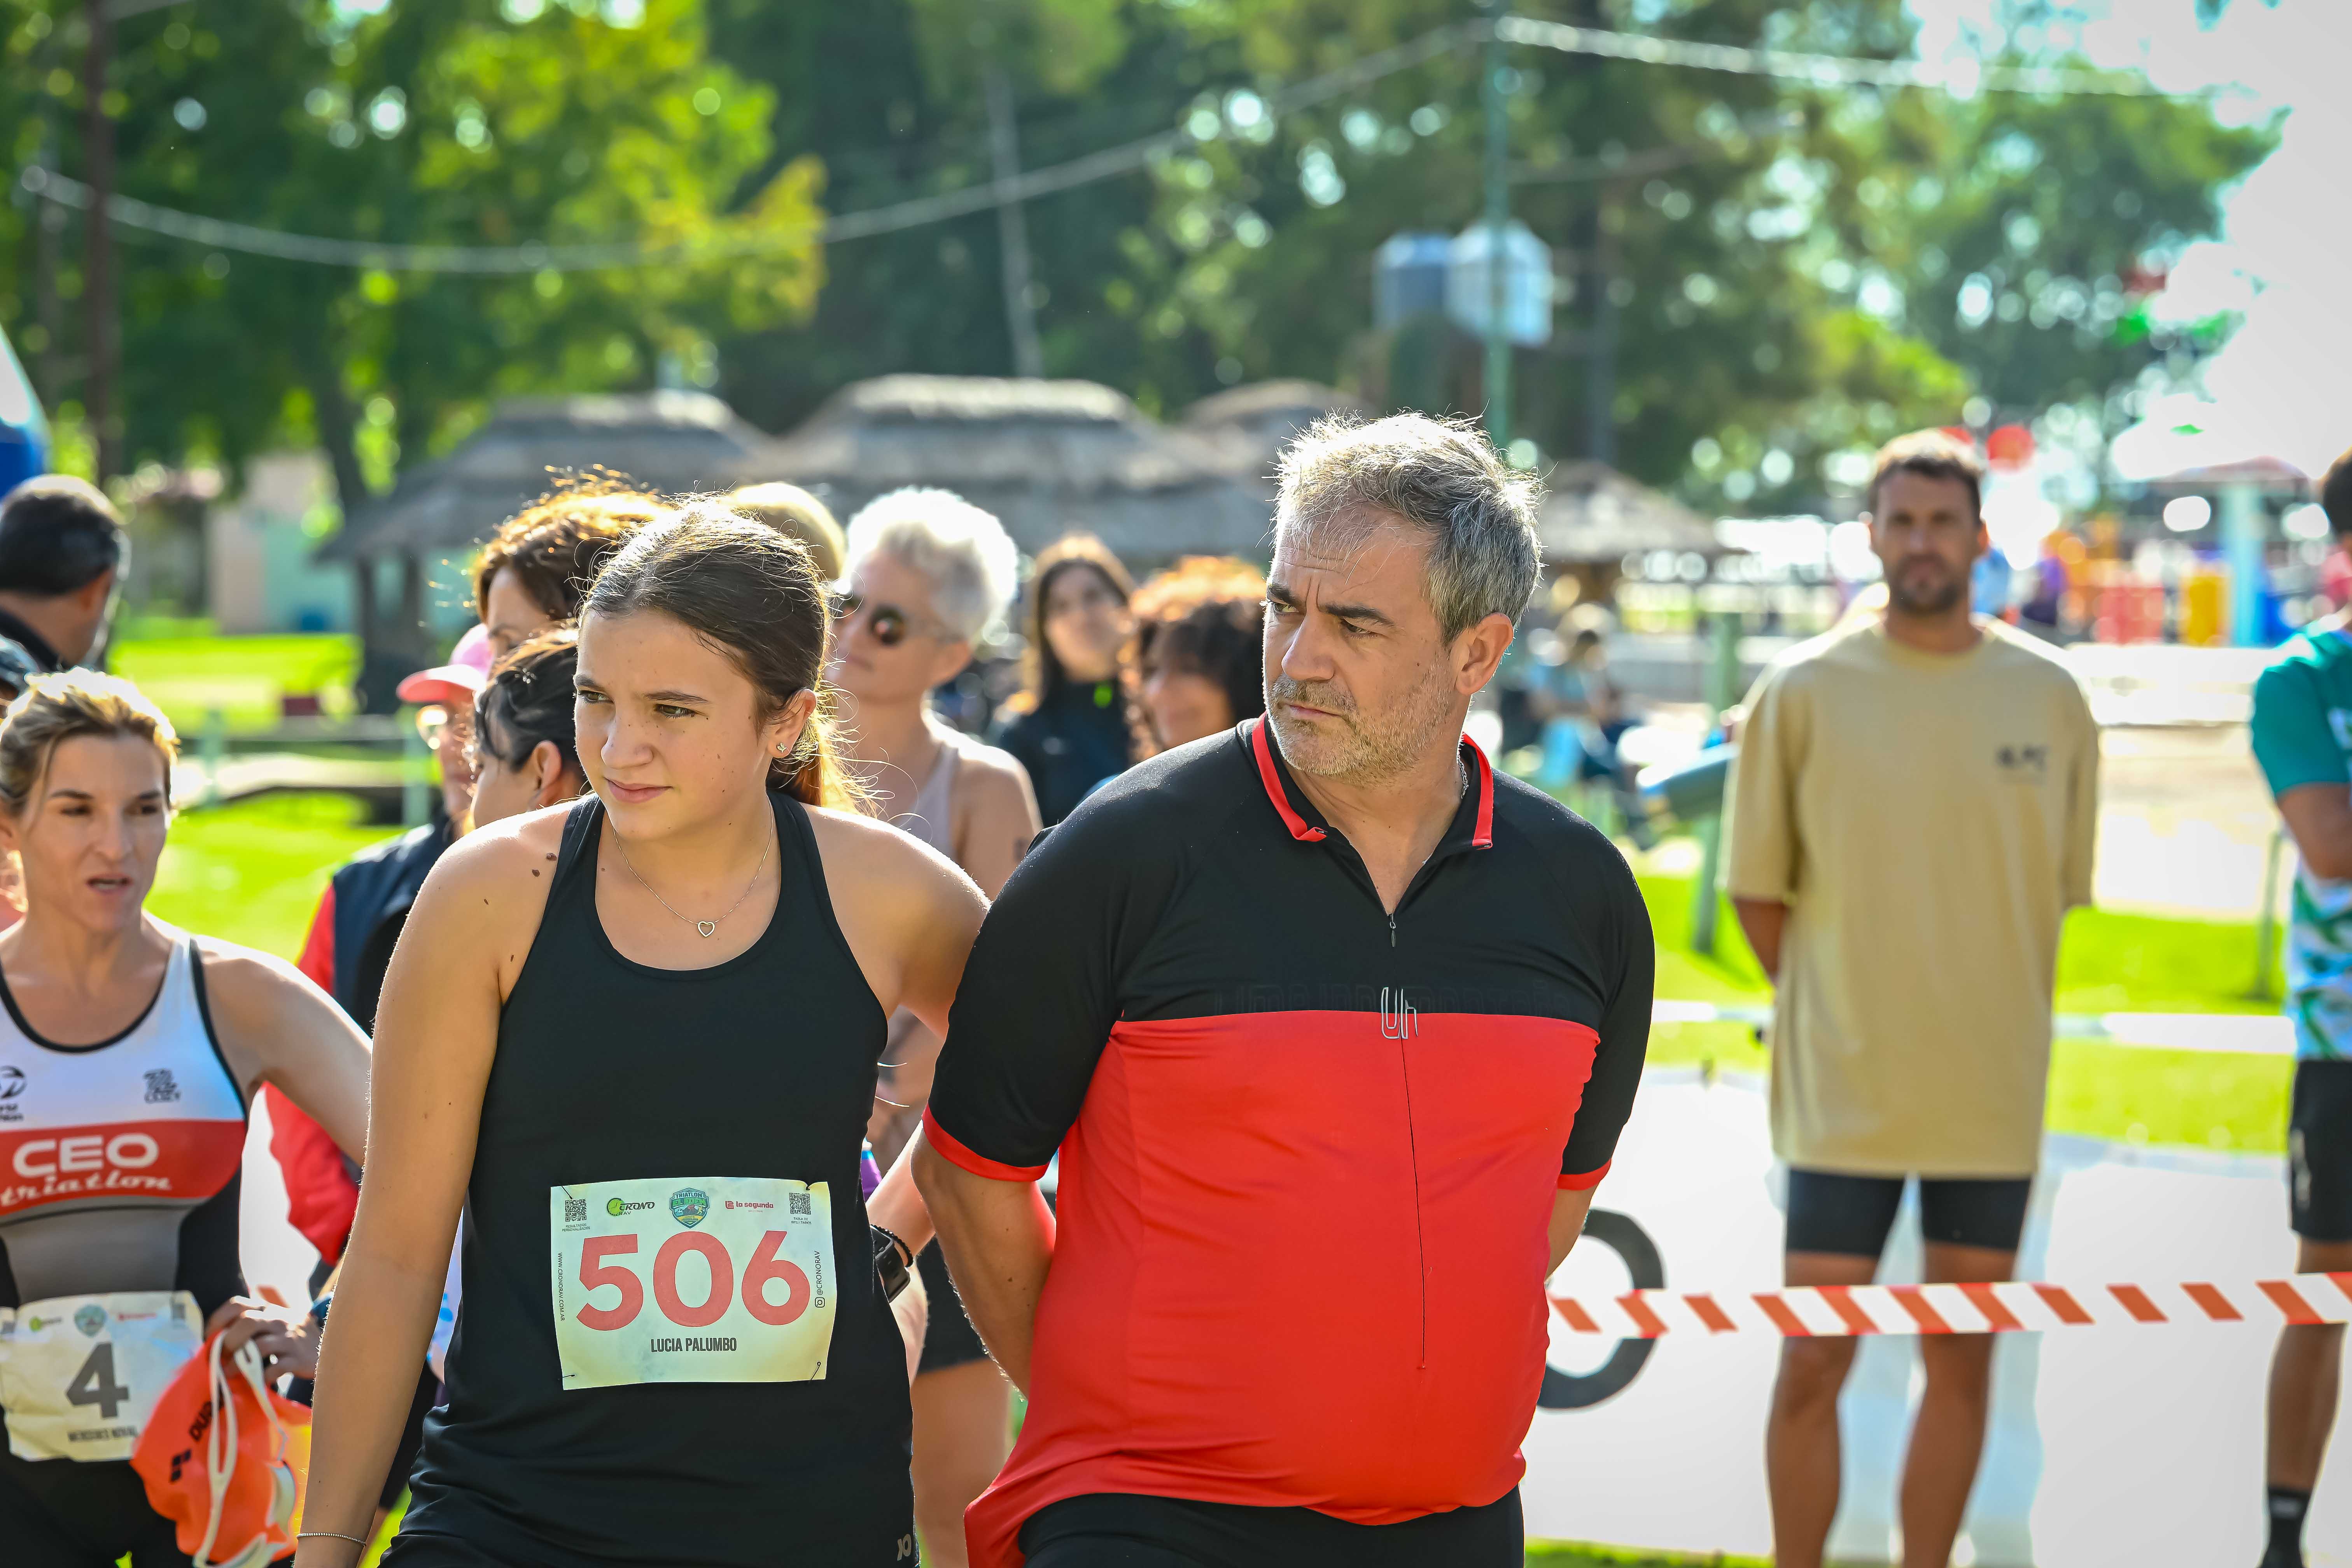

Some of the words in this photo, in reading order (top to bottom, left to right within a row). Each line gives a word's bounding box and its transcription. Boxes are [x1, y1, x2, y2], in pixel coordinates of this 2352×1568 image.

[13, 1132, 159, 1178] CEO
[0, 1169, 172, 1206] triatlon
[619, 1202, 655, 1211] CRONO
[576, 1230, 810, 1331] 506
[814, 1250, 823, 1295] @CRONORAV
[651, 1338, 683, 1353] LUCIA
[685, 1337, 737, 1351] PALUMBO
[65, 1342, 129, 1418] 4
